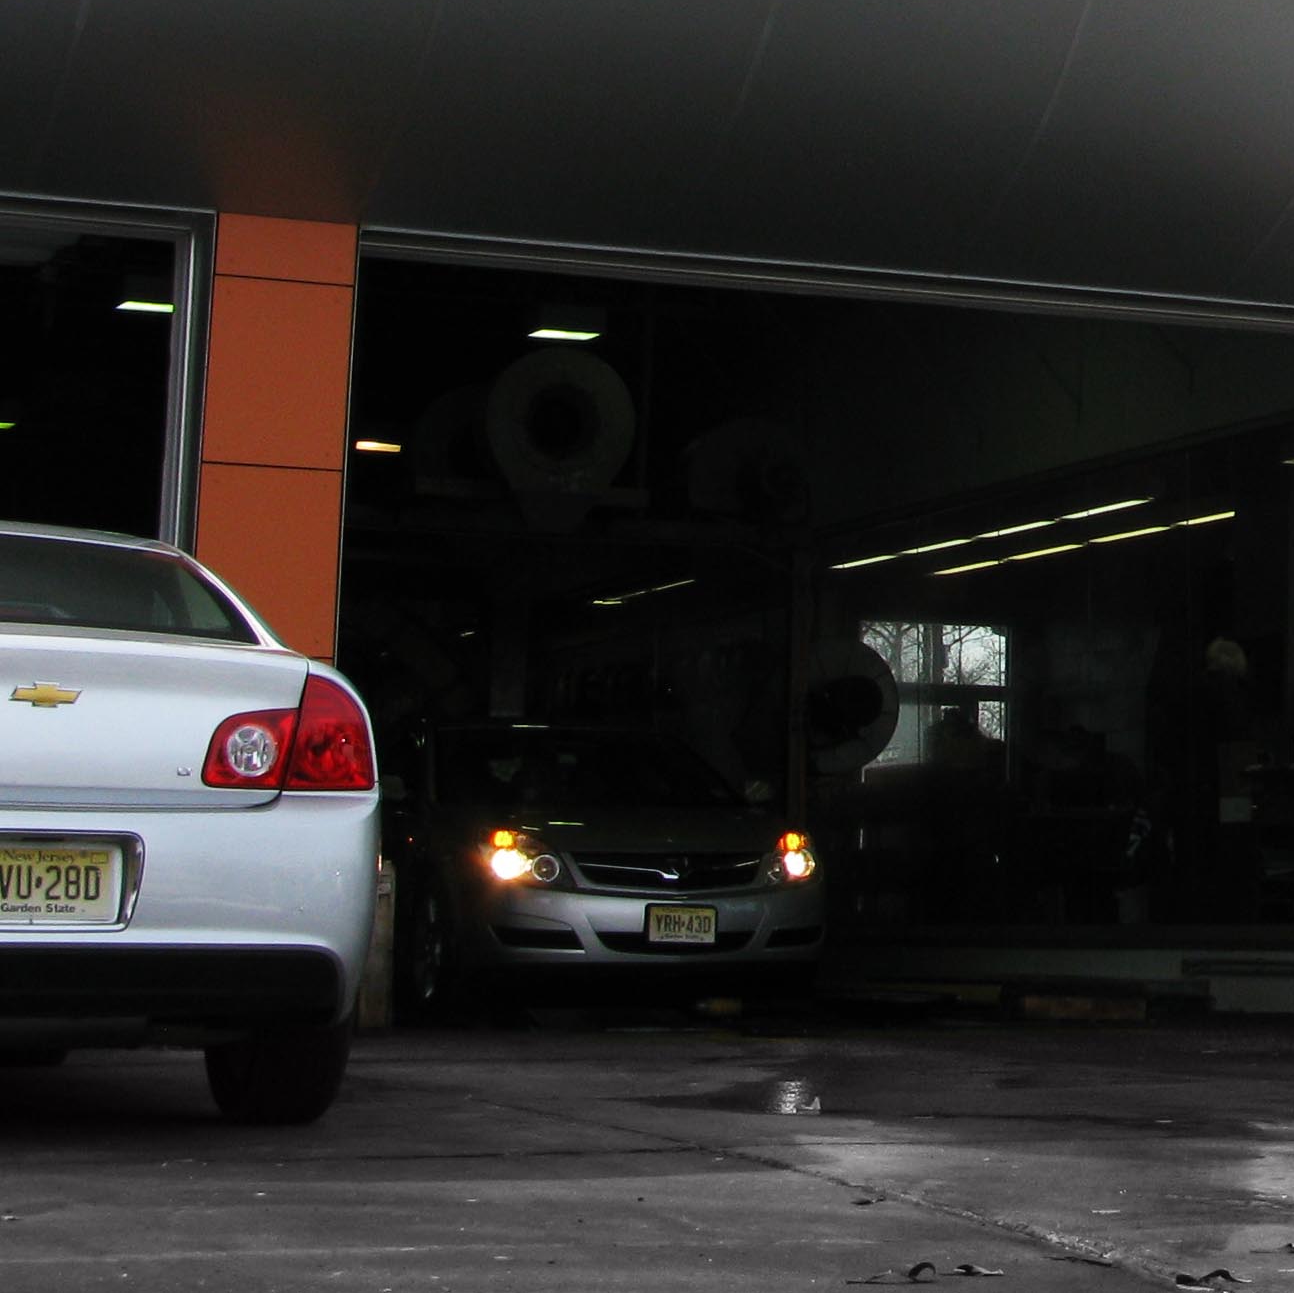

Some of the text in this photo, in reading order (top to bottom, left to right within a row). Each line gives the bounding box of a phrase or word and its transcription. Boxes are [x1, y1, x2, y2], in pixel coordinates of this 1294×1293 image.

[3, 850, 75, 865] New Jersey
[0, 903, 76, 913] Garden State
